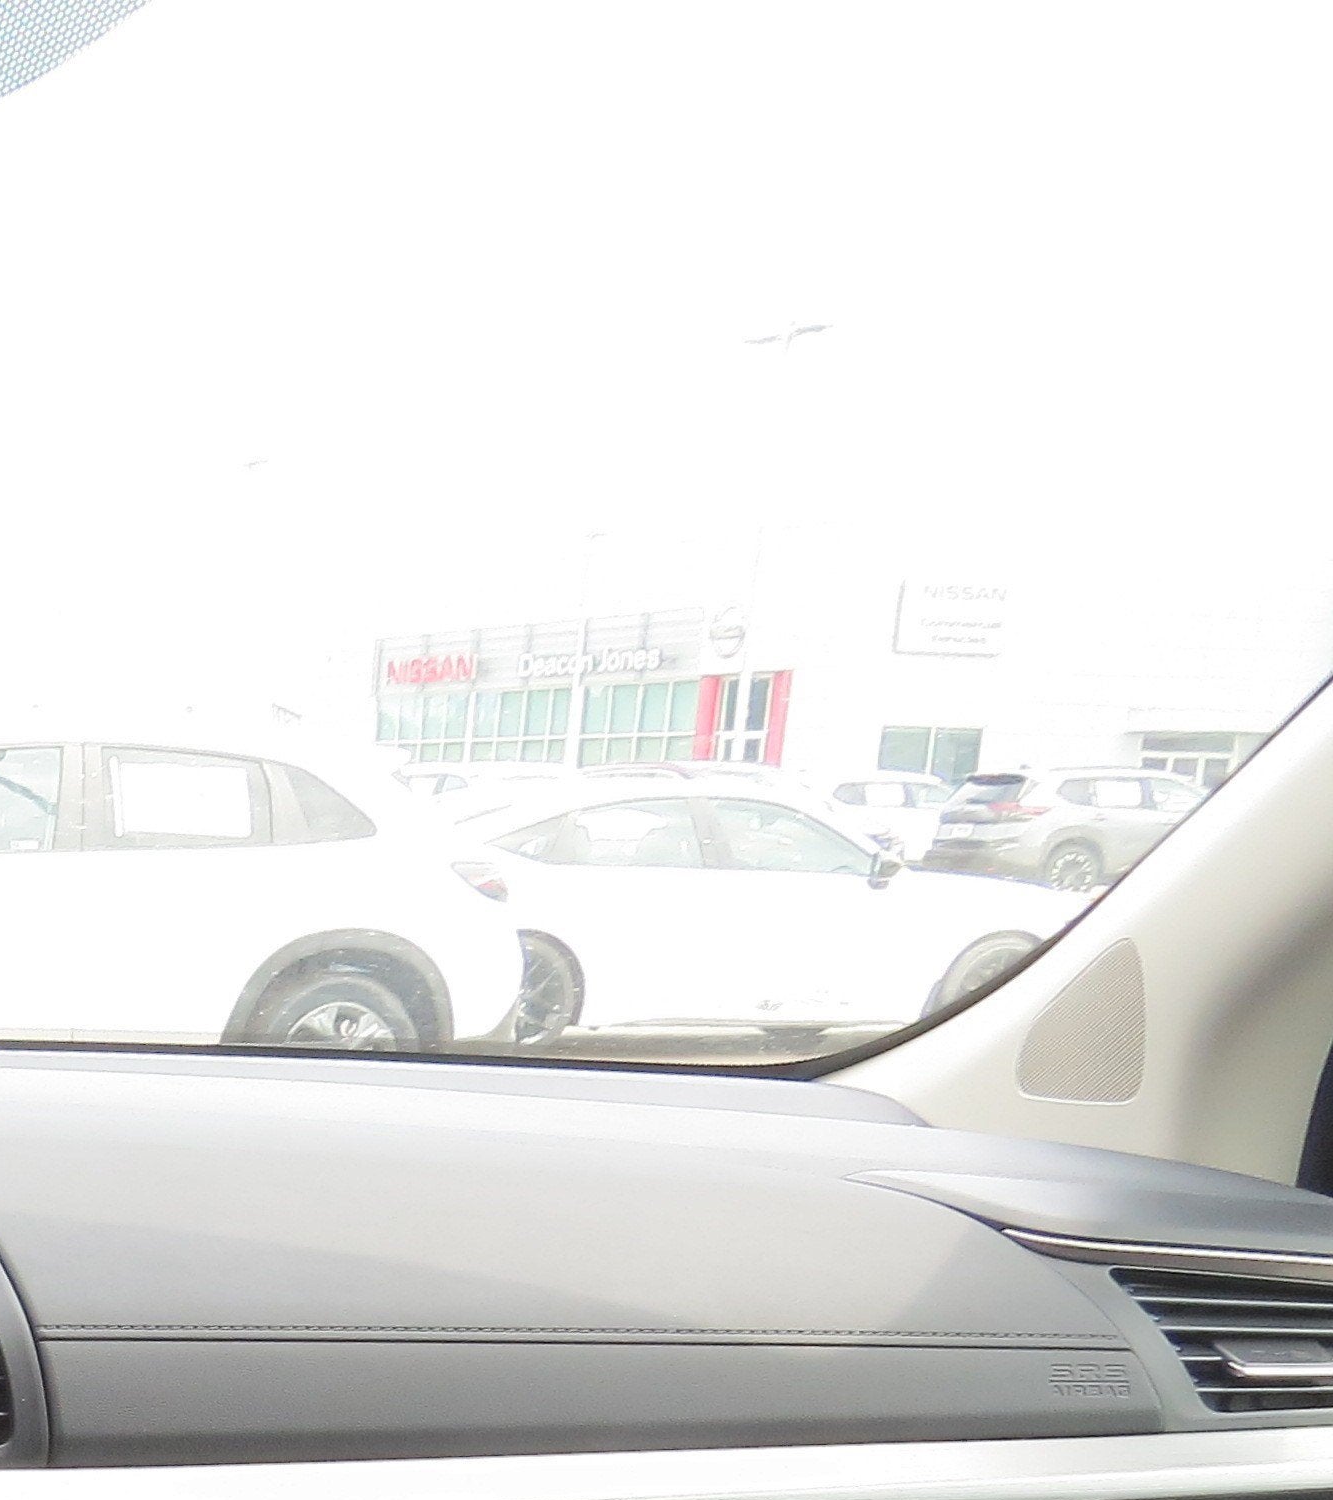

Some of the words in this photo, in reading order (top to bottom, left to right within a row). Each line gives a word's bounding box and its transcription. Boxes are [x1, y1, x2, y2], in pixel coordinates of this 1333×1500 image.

[385, 653, 479, 685] NISSAN
[517, 652, 594, 679] Deacon
[596, 645, 662, 673] Jones
[1049, 1363, 1127, 1379] SRS
[1053, 1384, 1131, 1398] AIRBAG
